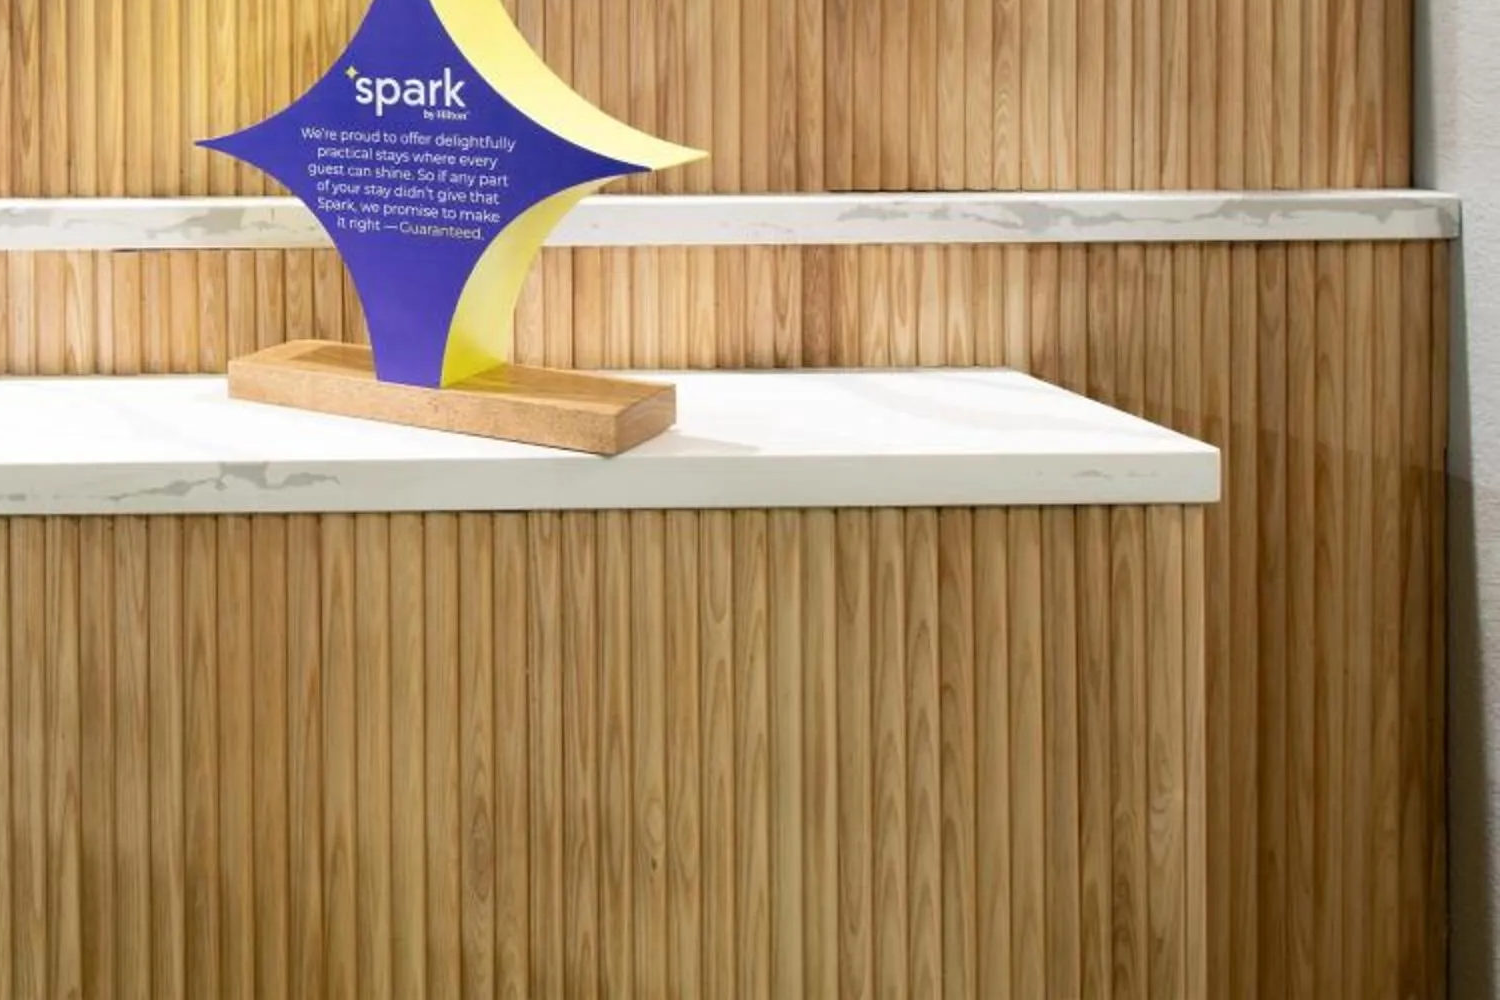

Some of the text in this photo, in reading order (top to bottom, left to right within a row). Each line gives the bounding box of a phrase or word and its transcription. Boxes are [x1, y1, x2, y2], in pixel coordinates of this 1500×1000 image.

[355, 67, 467, 116] spark
[423, 109, 435, 120] by
[301, 127, 516, 152] We're proud to offer delightfully
[317, 146, 498, 170] practical stays where every
[308, 162, 509, 188] guest can shine. So if any part
[317, 179, 500, 205] of your stay didn't give that
[317, 196, 501, 223] Spark, we promise to make
[337, 215, 346, 229] it
[348, 218, 381, 233] right
